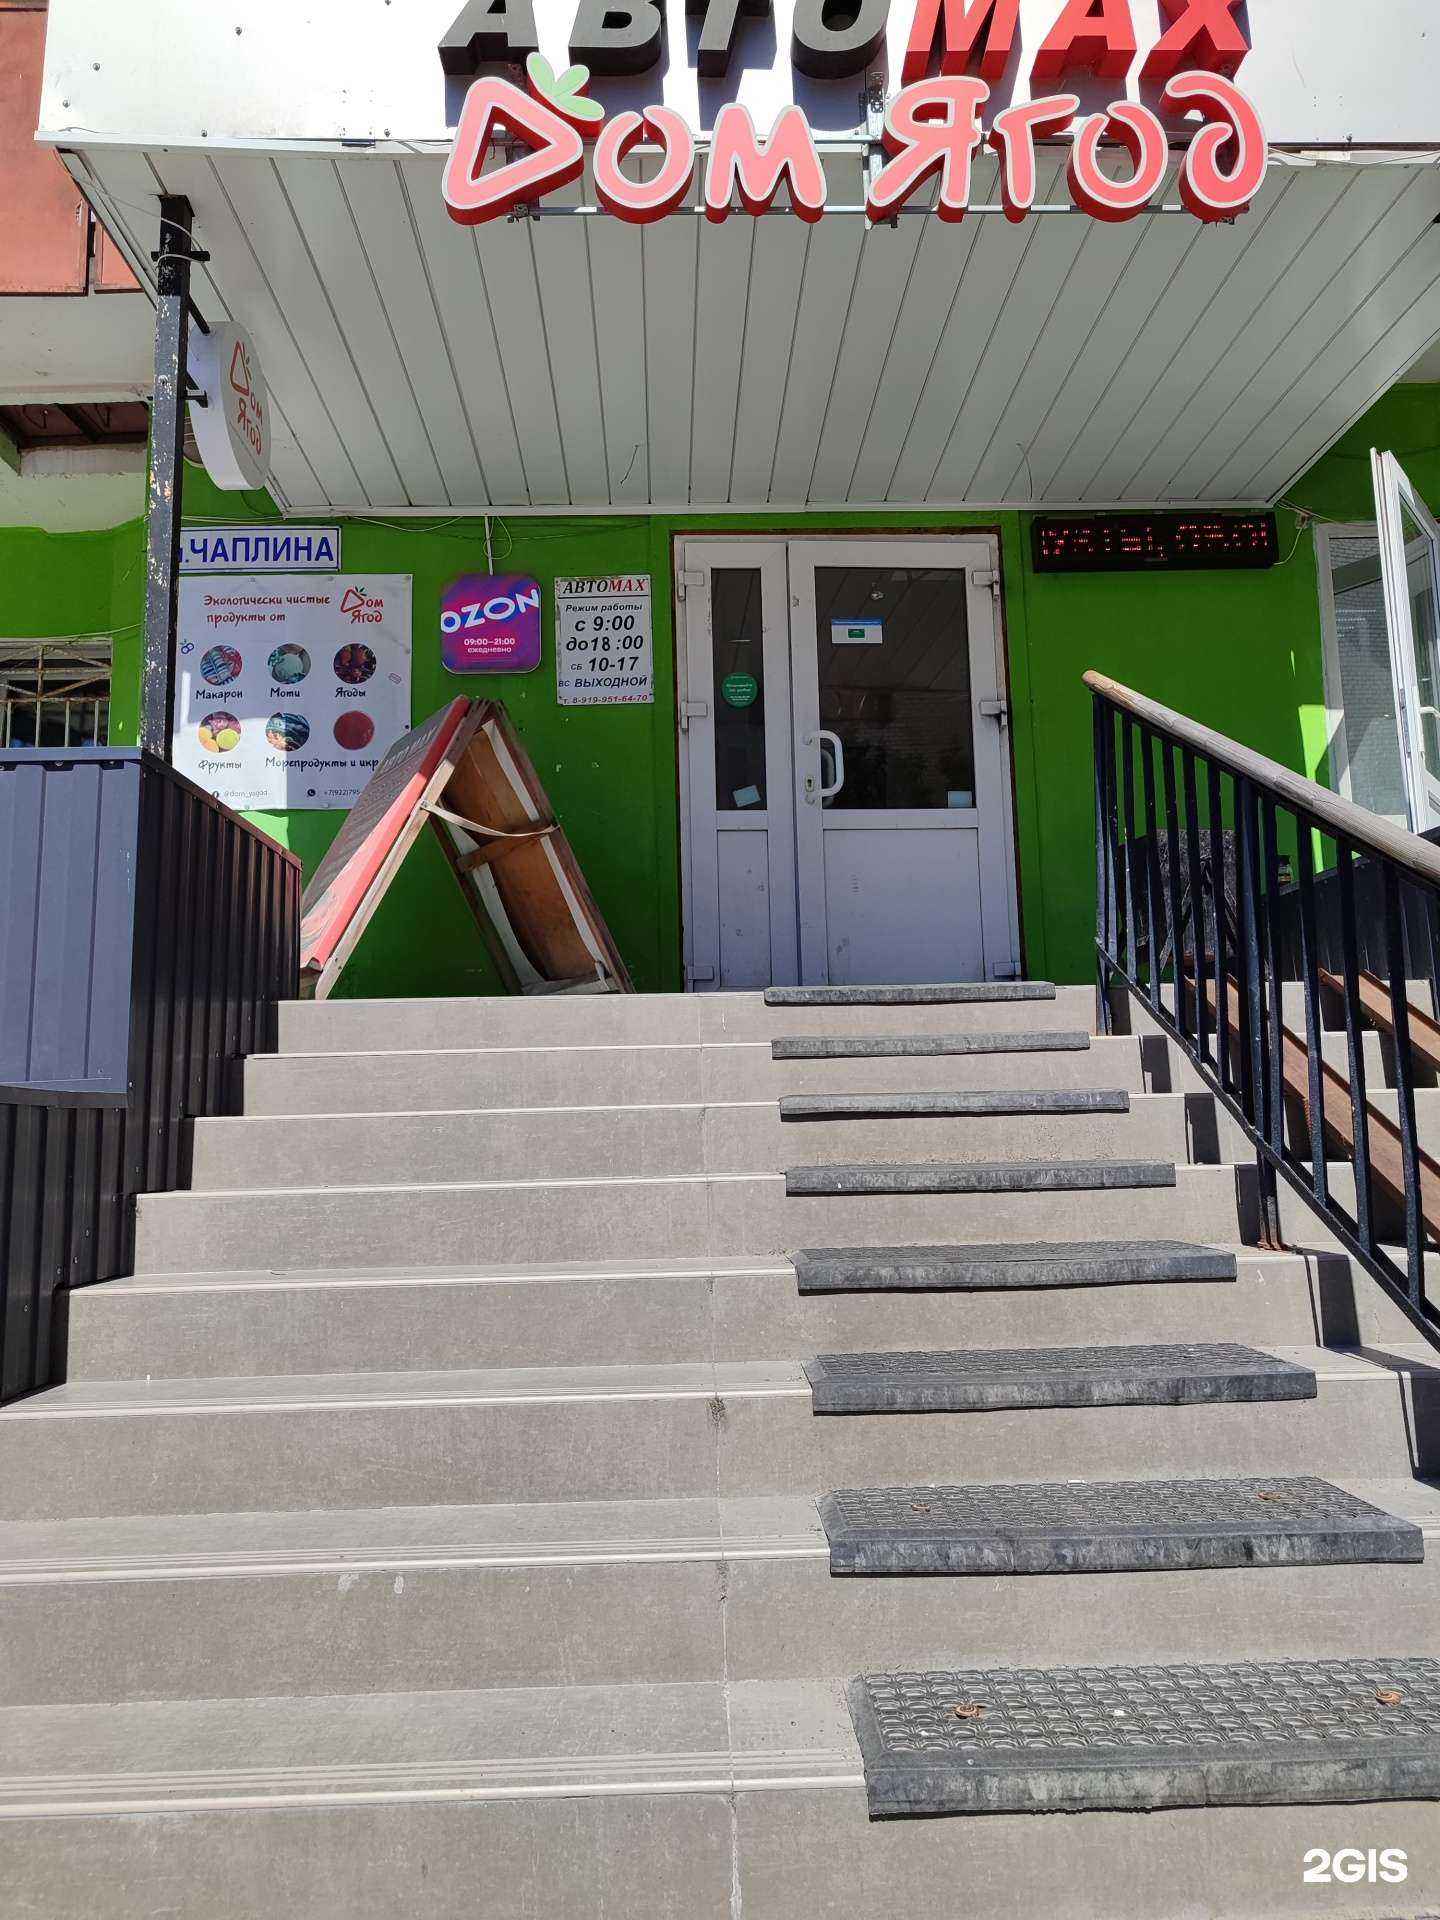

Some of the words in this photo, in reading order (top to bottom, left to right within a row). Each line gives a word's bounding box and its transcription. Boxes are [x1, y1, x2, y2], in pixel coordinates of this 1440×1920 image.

[868, 70, 1269, 222] Ягод
[203, 594, 283, 606] Экологически
[286, 594, 330, 605] чистые
[566, 604, 599, 612] Режим
[601, 603, 642, 613] работы
[350, 609, 383, 624] Ягод
[440, 588, 540, 634] OZON
[206, 611, 266, 628] продукты
[270, 613, 286, 622] от
[593, 615, 635, 631] 9:00
[588, 656, 639, 672] 10-17
[574, 675, 648, 688] ВЫХОДНОЙ
[195, 689, 243, 706] Макарон
[270, 687, 301, 699] Моти
[335, 687, 367, 699] Ягоды
[198, 758, 243, 774] Фрукты
[265, 757, 347, 773] Морепродукты
[350, 759, 356, 767] и
[359, 759, 379, 771] икр
